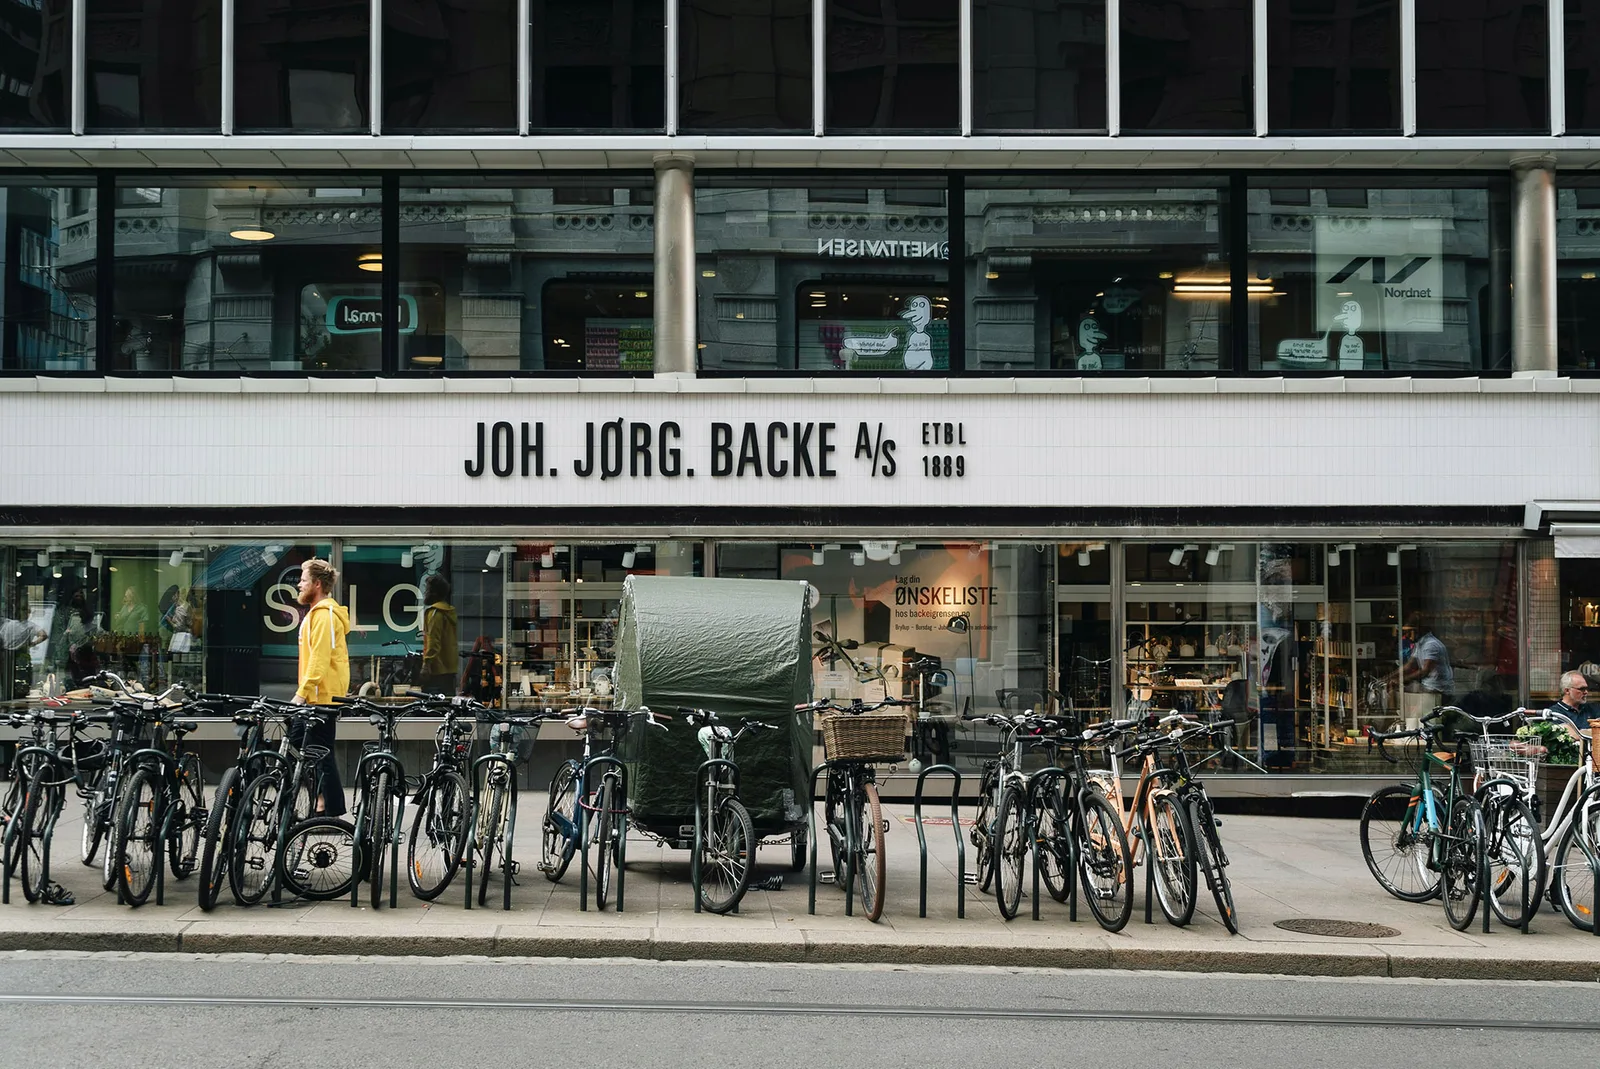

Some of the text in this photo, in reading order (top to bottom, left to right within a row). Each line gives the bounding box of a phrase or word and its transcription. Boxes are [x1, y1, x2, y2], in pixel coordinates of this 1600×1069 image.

[1384, 287, 1432, 298] Nordnet
[922, 422, 967, 446] ETBL
[464, 417, 898, 482] JOH. JØRG. BACKE A/S
[922, 455, 966, 478] 1889
[895, 575, 921, 584] Lag din
[896, 587, 998, 605] ØNSKELISTE
[263, 583, 425, 633] SLG
[895, 609, 971, 619] hos backeigrensenno
